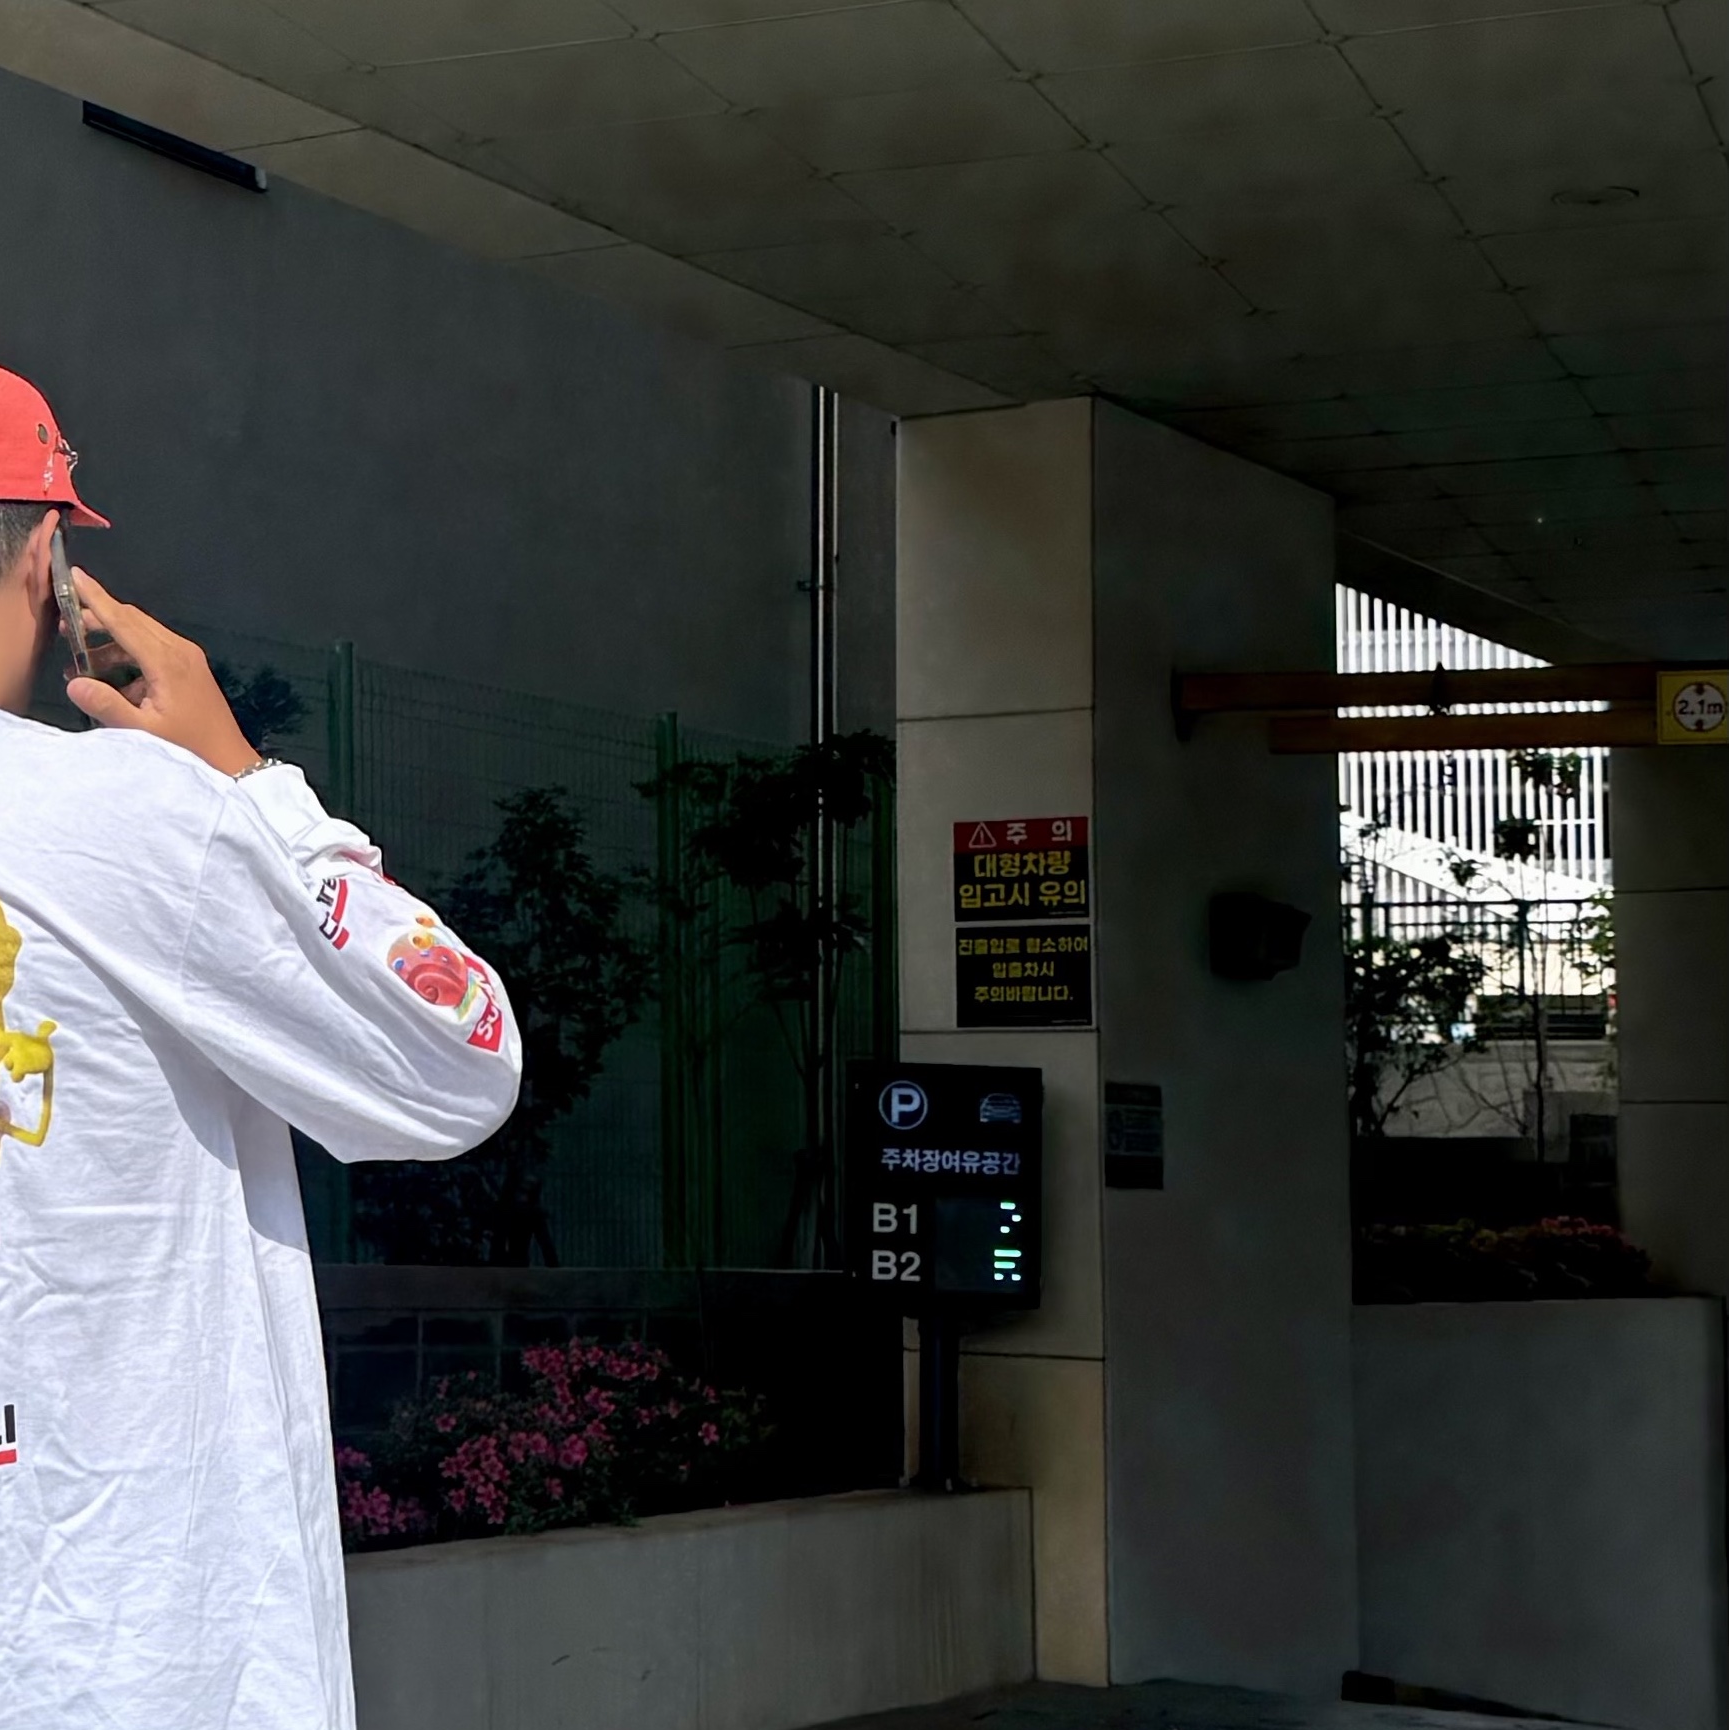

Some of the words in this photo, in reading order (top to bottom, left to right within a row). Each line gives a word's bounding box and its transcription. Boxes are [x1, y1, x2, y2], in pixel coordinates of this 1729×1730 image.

[1678, 700, 1723, 715] 2.1m
[974, 850, 1071, 878] 대형차량
[959, 882, 1030, 909] 입고시
[1039, 879, 1086, 906] 유의
[881, 1148, 1021, 1175] 주차장여유공간
[872, 1202, 918, 1235] B1
[871, 1250, 921, 1282] B2
